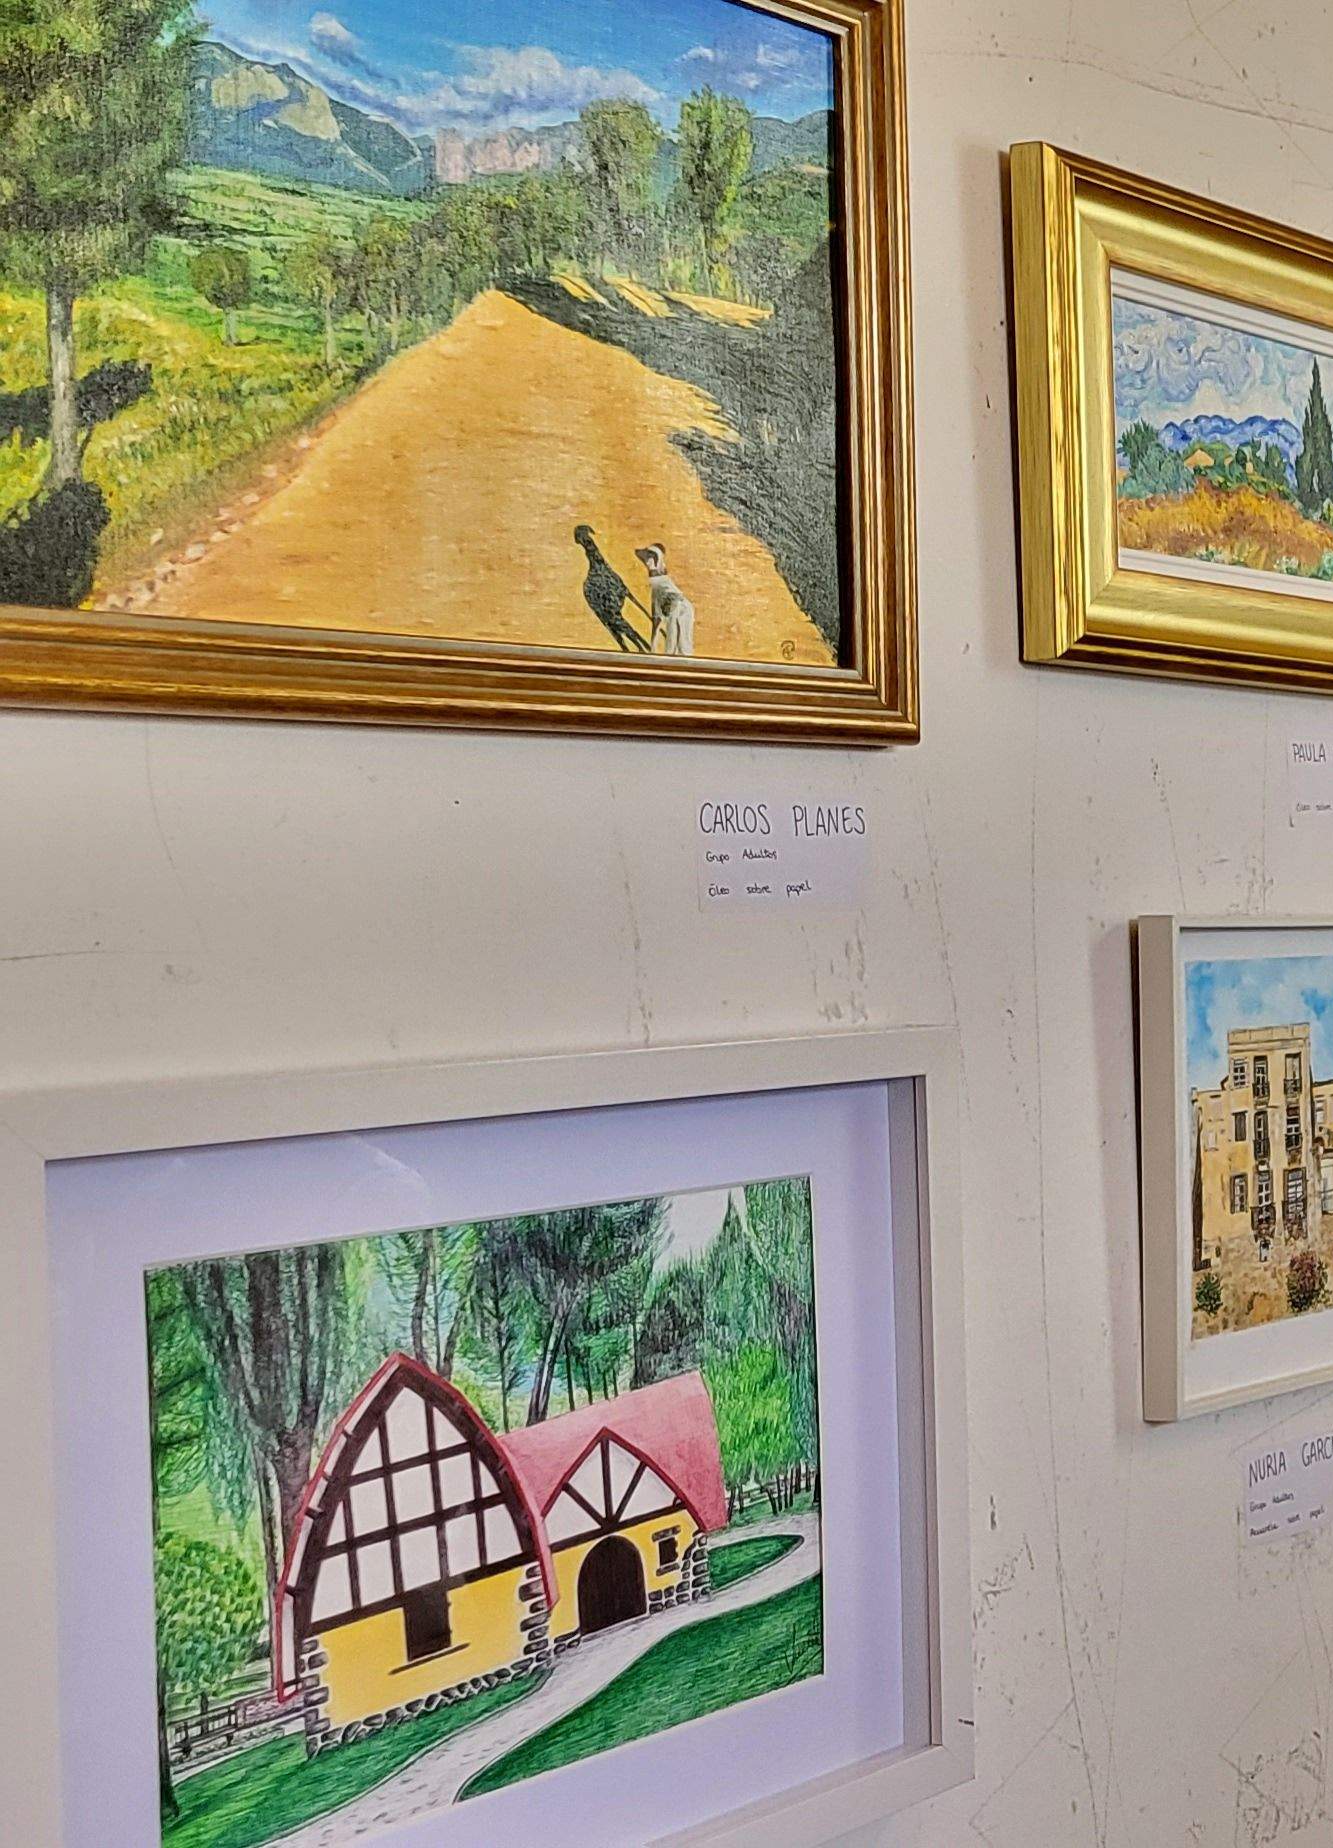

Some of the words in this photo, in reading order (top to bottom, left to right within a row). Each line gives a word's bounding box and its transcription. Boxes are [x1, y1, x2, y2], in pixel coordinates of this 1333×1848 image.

[1292, 743, 1327, 763] PAULA
[699, 802, 771, 834] CARLOS
[792, 805, 866, 836] PLANES
[746, 883, 772, 895] sobre
[786, 880, 812, 898] papel
[1248, 1451, 1287, 1488] NURIA
